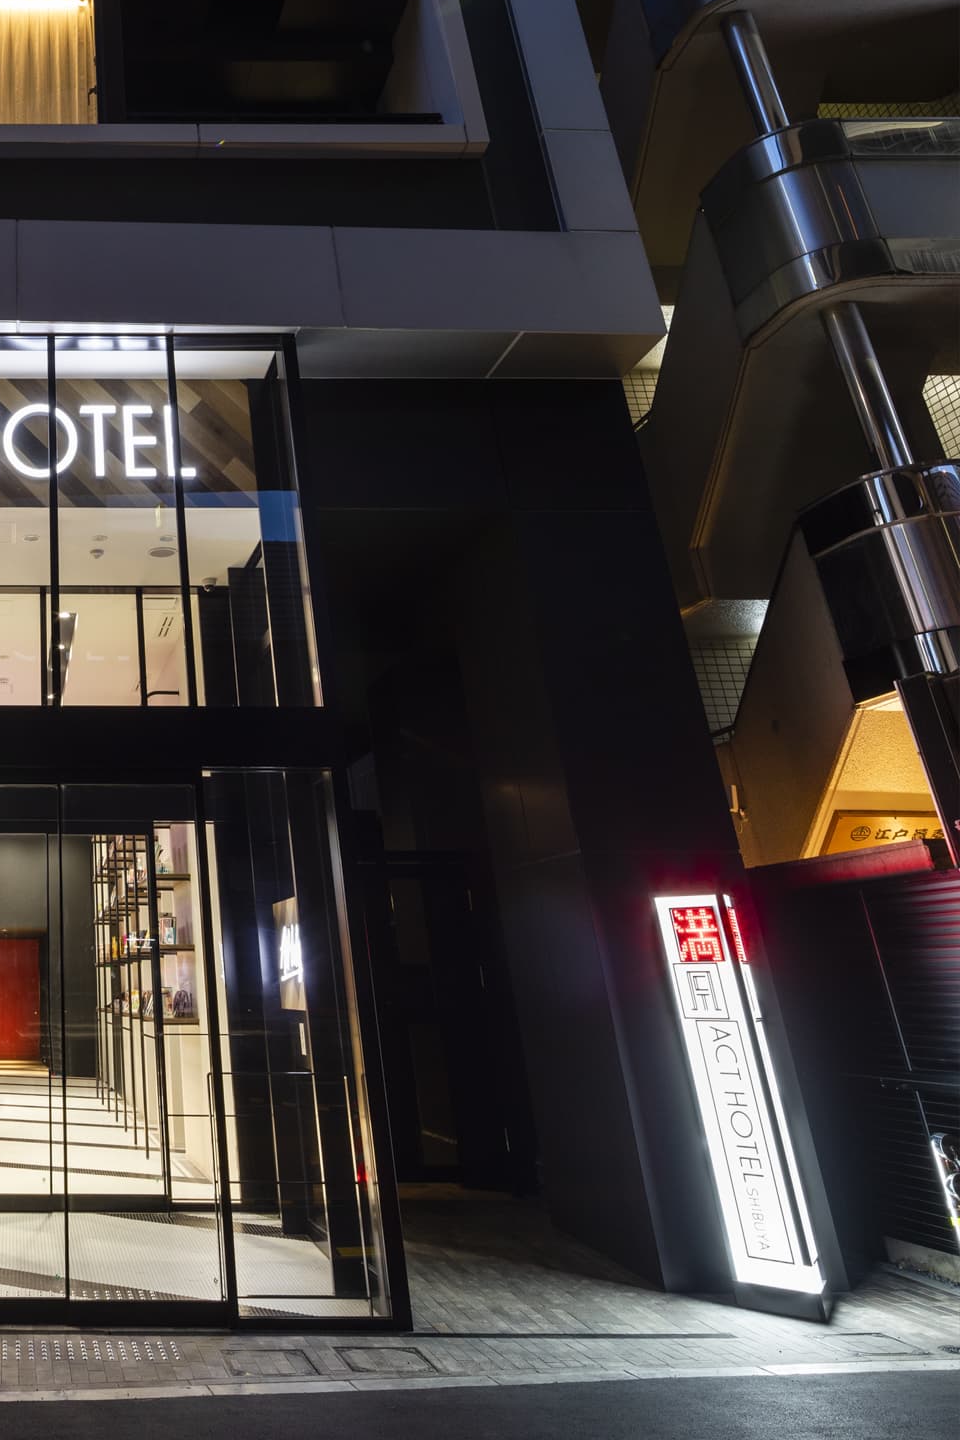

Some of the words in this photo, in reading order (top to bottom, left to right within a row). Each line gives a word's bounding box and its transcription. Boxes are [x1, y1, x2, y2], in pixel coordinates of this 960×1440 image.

[709, 1025, 743, 1081] ACT
[723, 1090, 765, 1184] HOTEL
[745, 1186, 772, 1252] SHIBUYA
